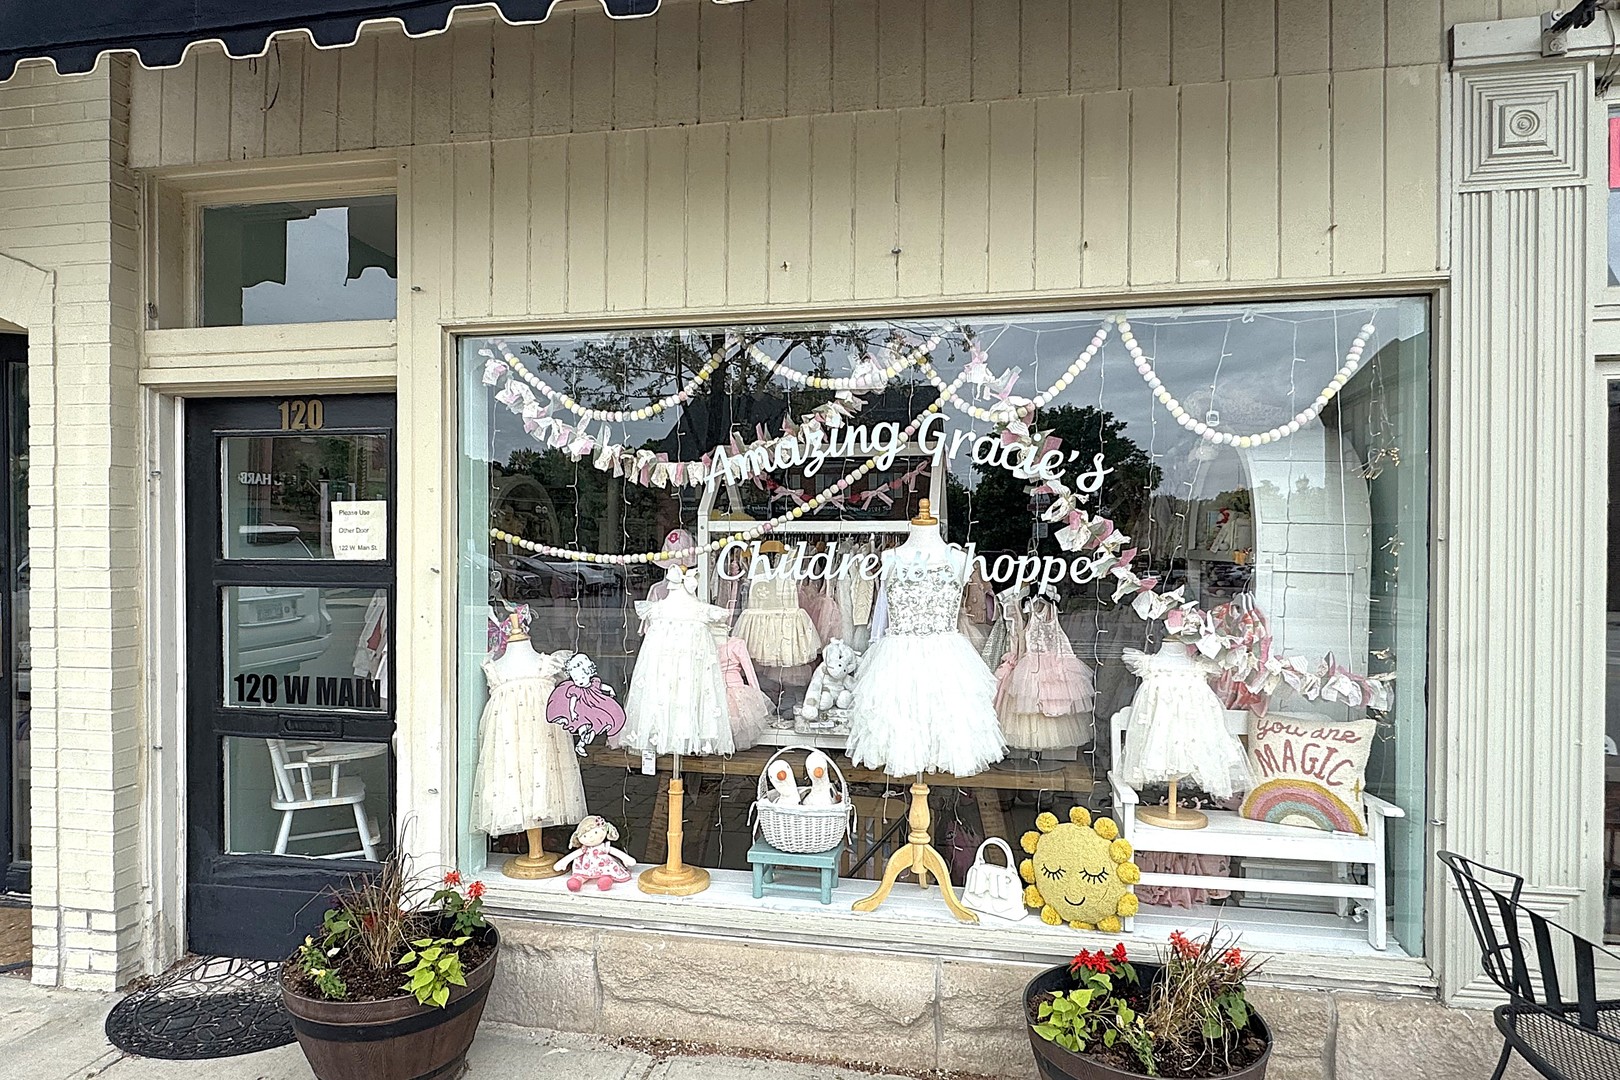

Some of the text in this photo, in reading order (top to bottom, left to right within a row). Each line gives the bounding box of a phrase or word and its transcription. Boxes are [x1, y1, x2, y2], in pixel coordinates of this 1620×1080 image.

[278, 399, 324, 430] 120
[704, 412, 1115, 494] Amazing Gracie's
[939, 541, 1098, 595] Shoppe
[233, 673, 381, 708] 120 W MAIN
[1256, 718, 1362, 744] you are
[1254, 739, 1355, 787] MAGIC
